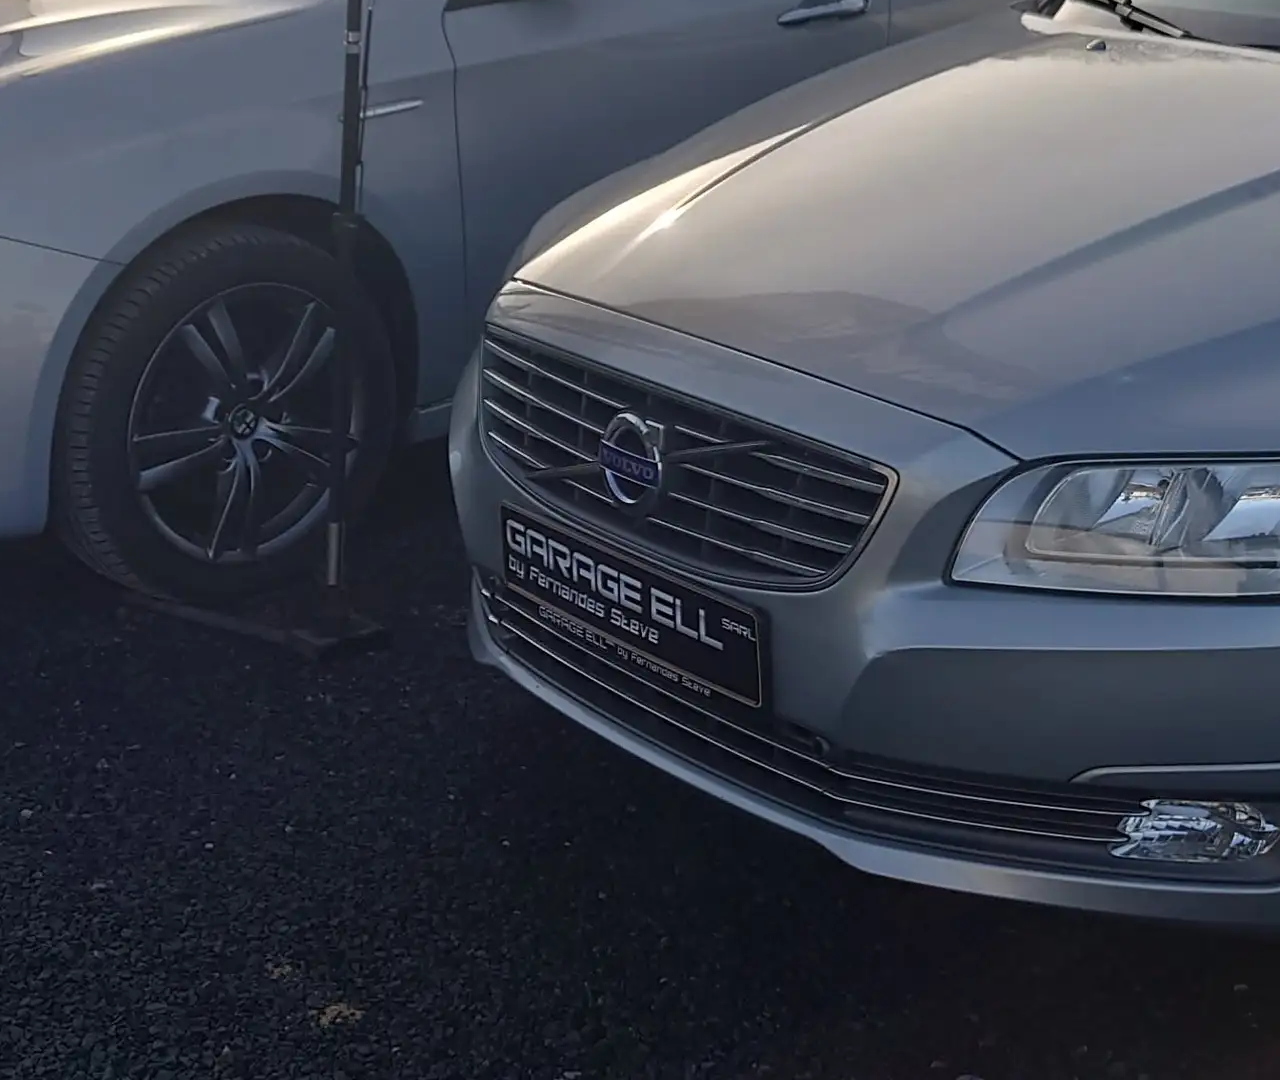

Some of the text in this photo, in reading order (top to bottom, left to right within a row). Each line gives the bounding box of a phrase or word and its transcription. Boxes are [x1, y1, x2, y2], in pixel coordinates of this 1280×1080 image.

[602, 447, 655, 480] VOLVO
[506, 518, 757, 651] GARAGE ELL SARL
[507, 554, 660, 644] by Fernandes Steve
[538, 604, 583, 639] GARAGE
[584, 631, 608, 650] ELL
[616, 646, 629, 662] by
[681, 675, 712, 698] Steve
